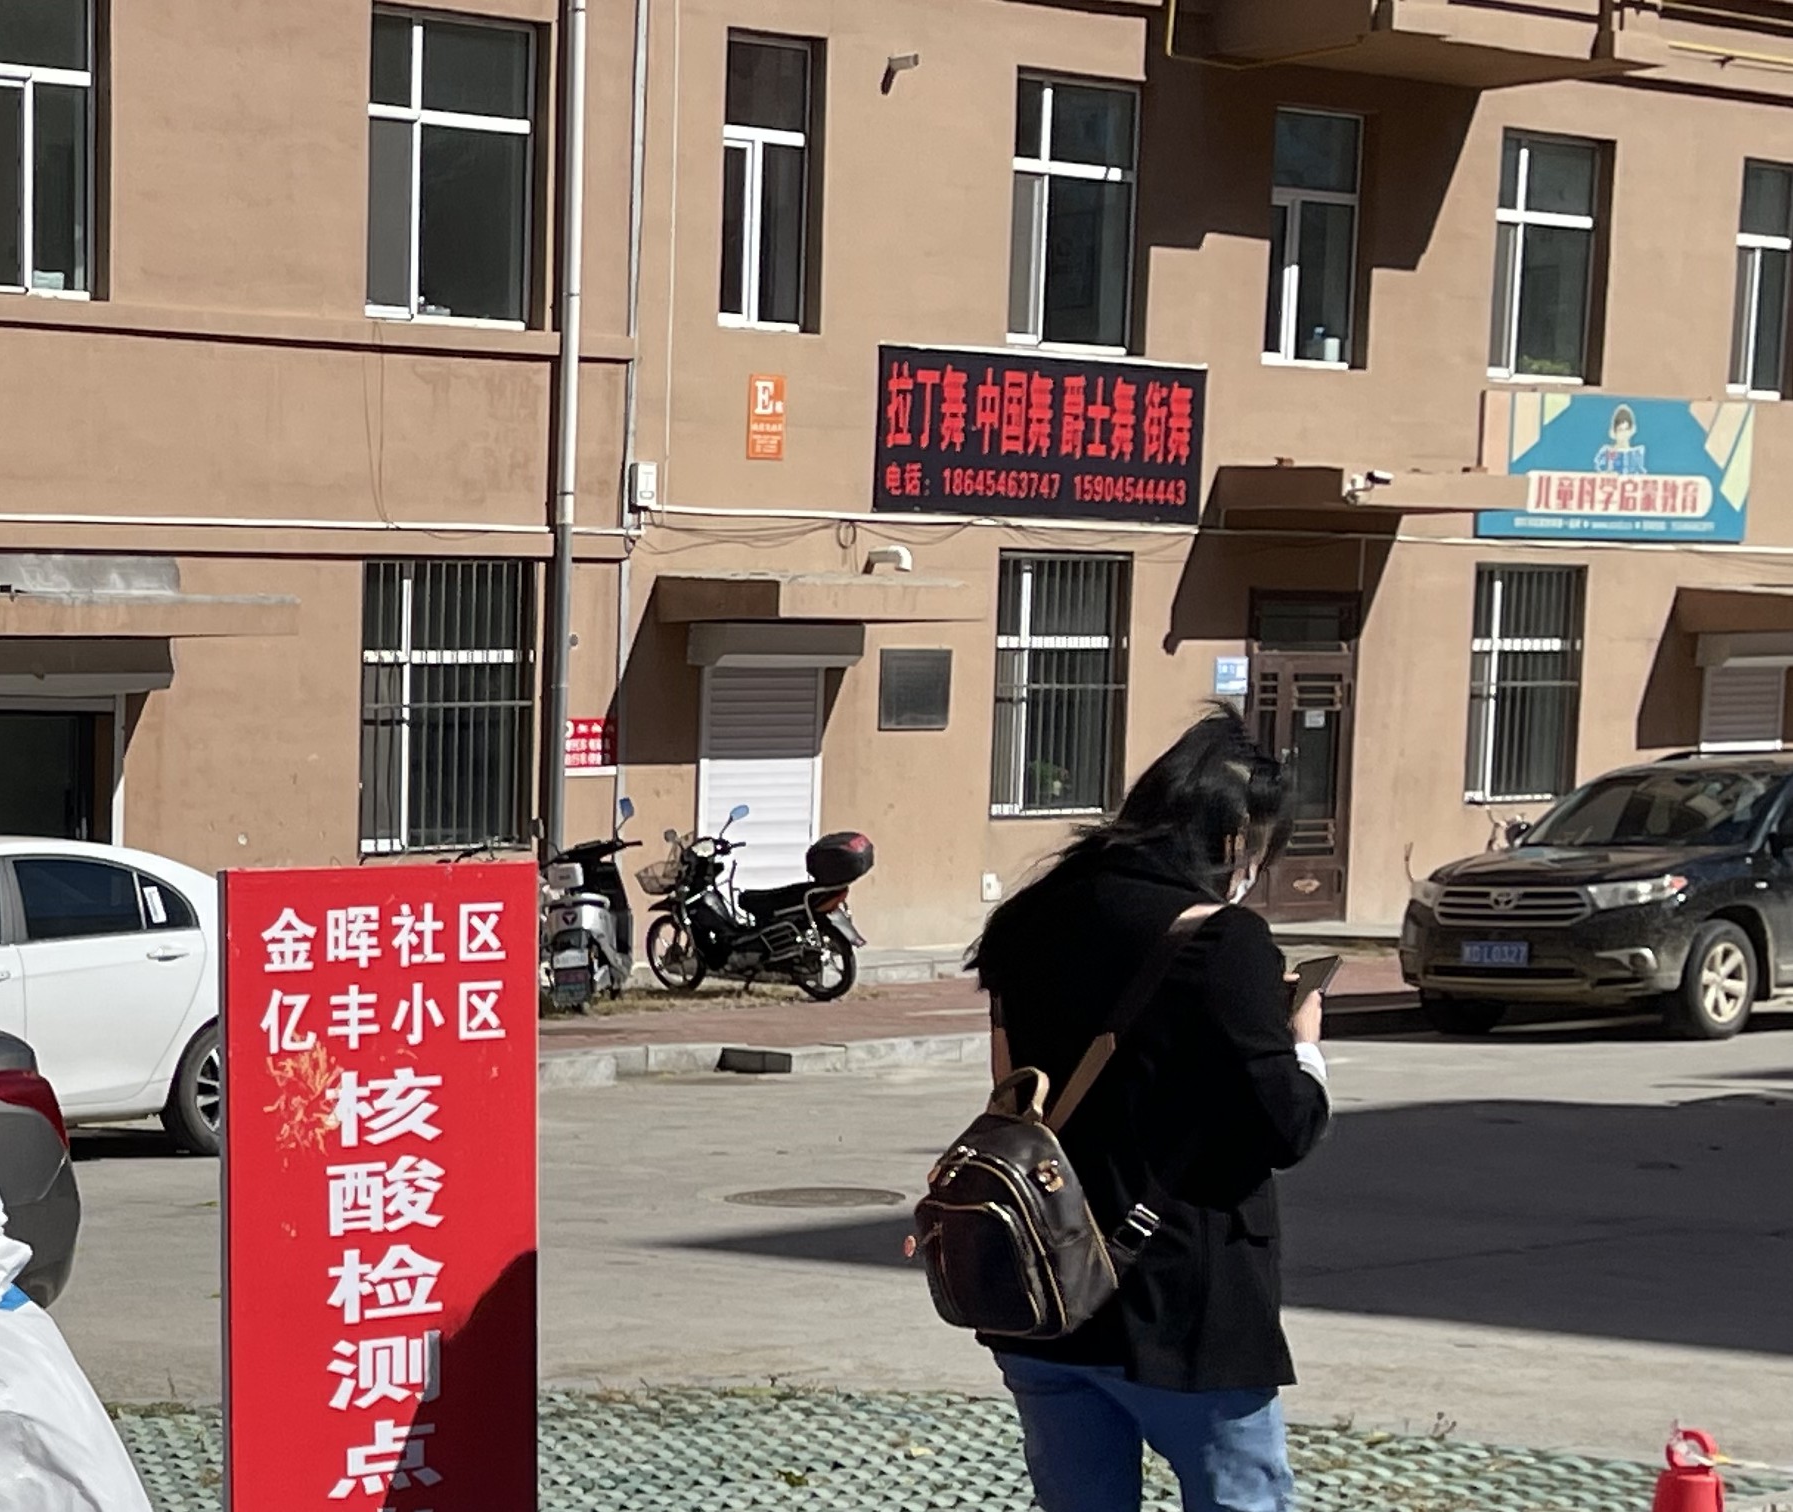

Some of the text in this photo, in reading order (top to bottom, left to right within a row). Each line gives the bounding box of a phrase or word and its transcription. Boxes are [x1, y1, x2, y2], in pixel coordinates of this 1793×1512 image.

[1073, 474, 1188, 505] 15904544443
[260, 901, 507, 973] 金晖社区
[259, 980, 507, 1054] 亿丰小区
